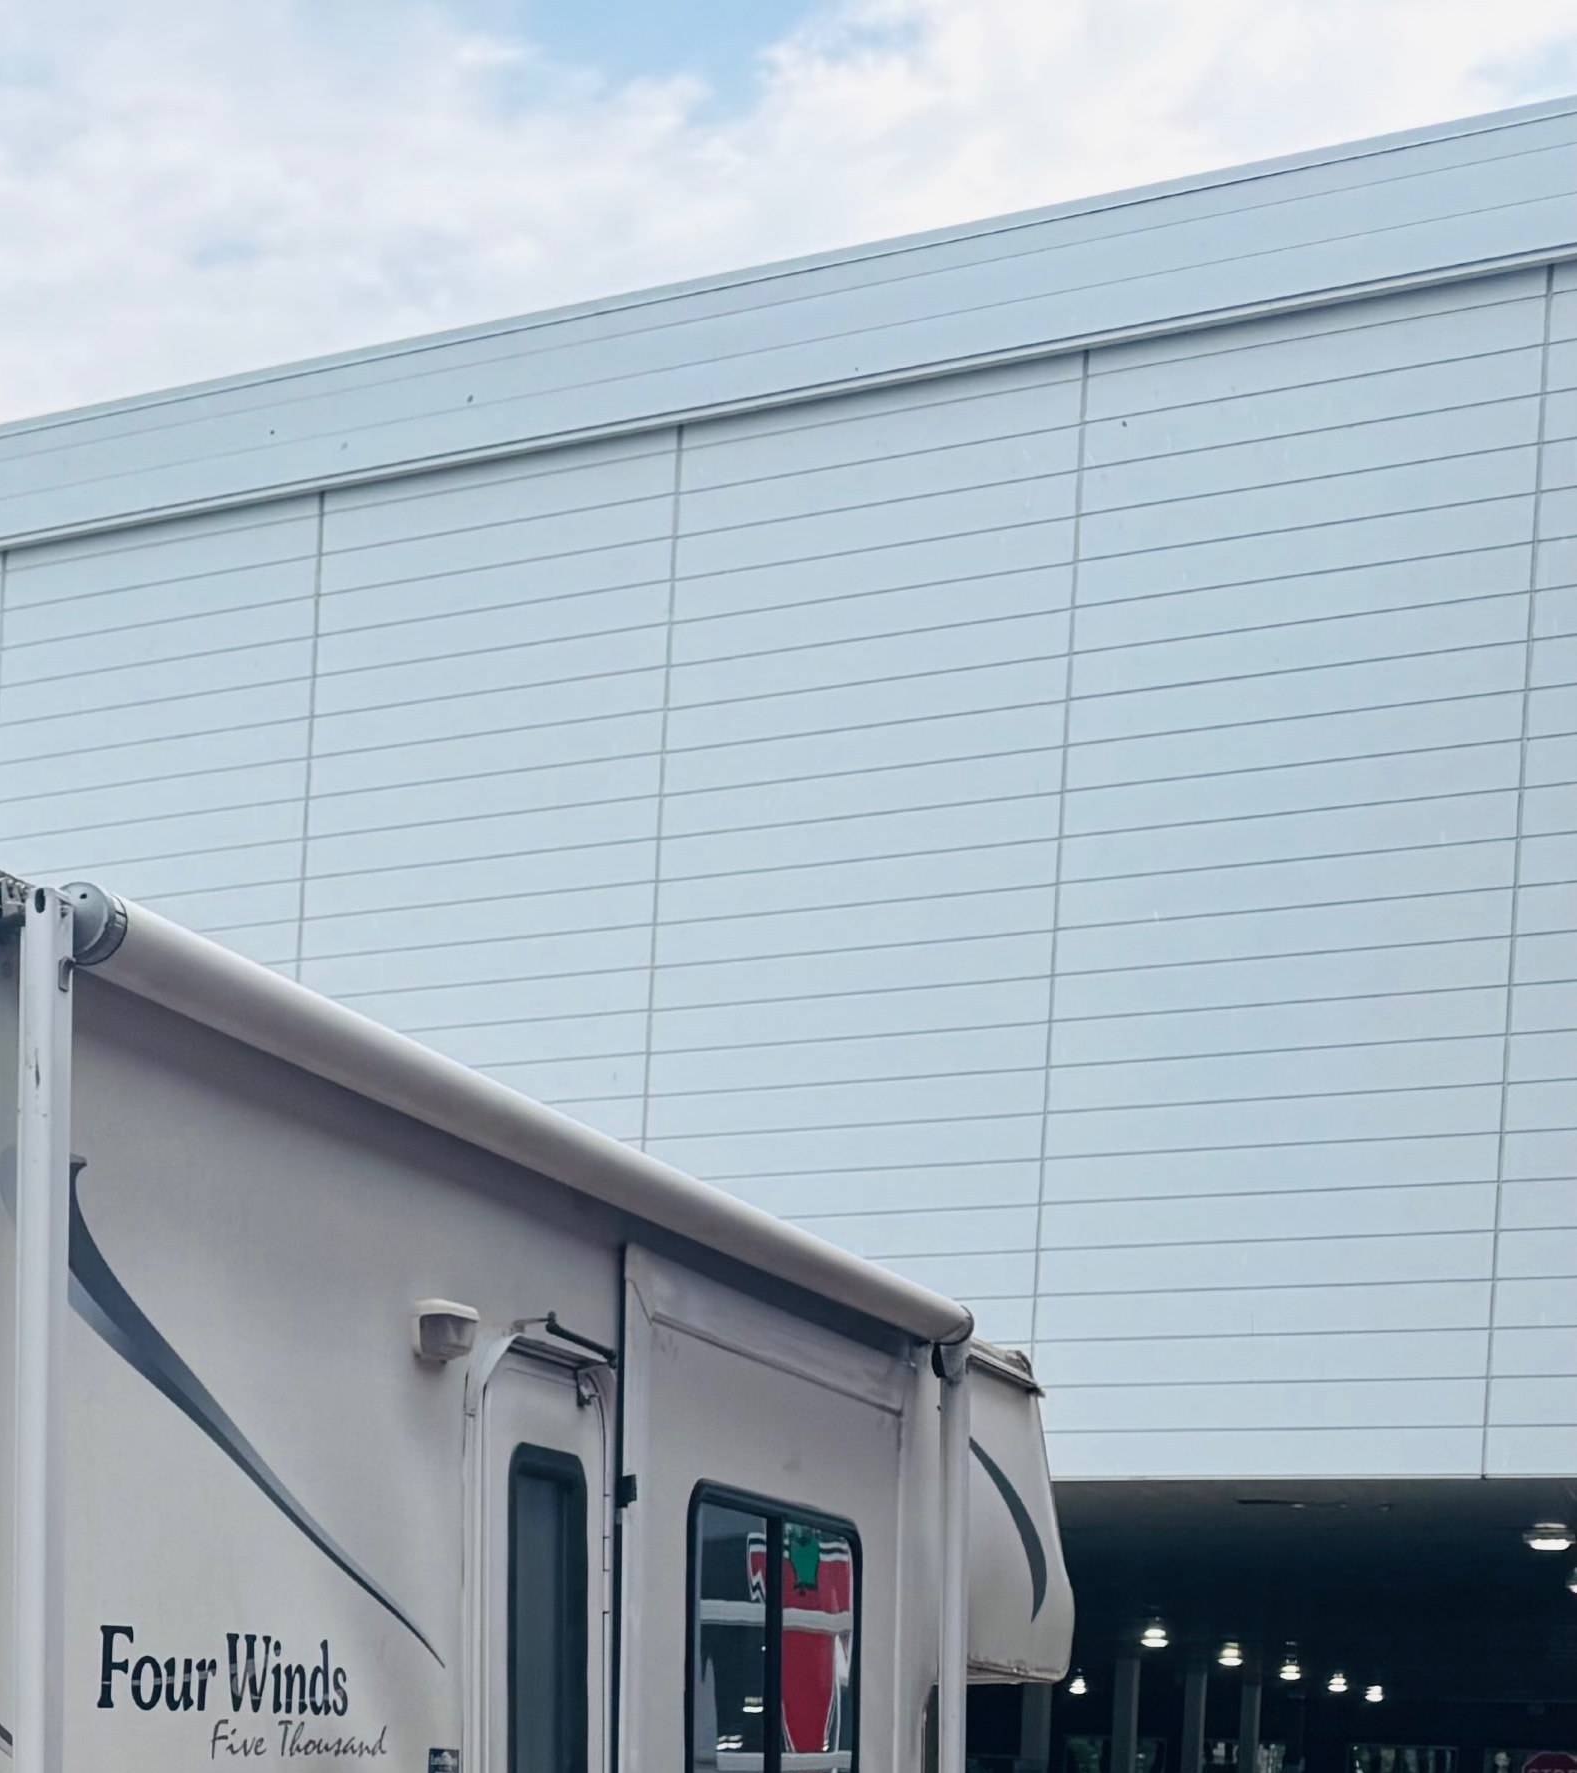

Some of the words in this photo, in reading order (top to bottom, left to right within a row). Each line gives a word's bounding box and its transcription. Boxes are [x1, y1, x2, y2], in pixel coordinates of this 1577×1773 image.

[97, 1625, 217, 1711] Four
[226, 1632, 348, 1716] Winds
[211, 1719, 266, 1760] Five
[278, 1720, 387, 1758] Thousand
